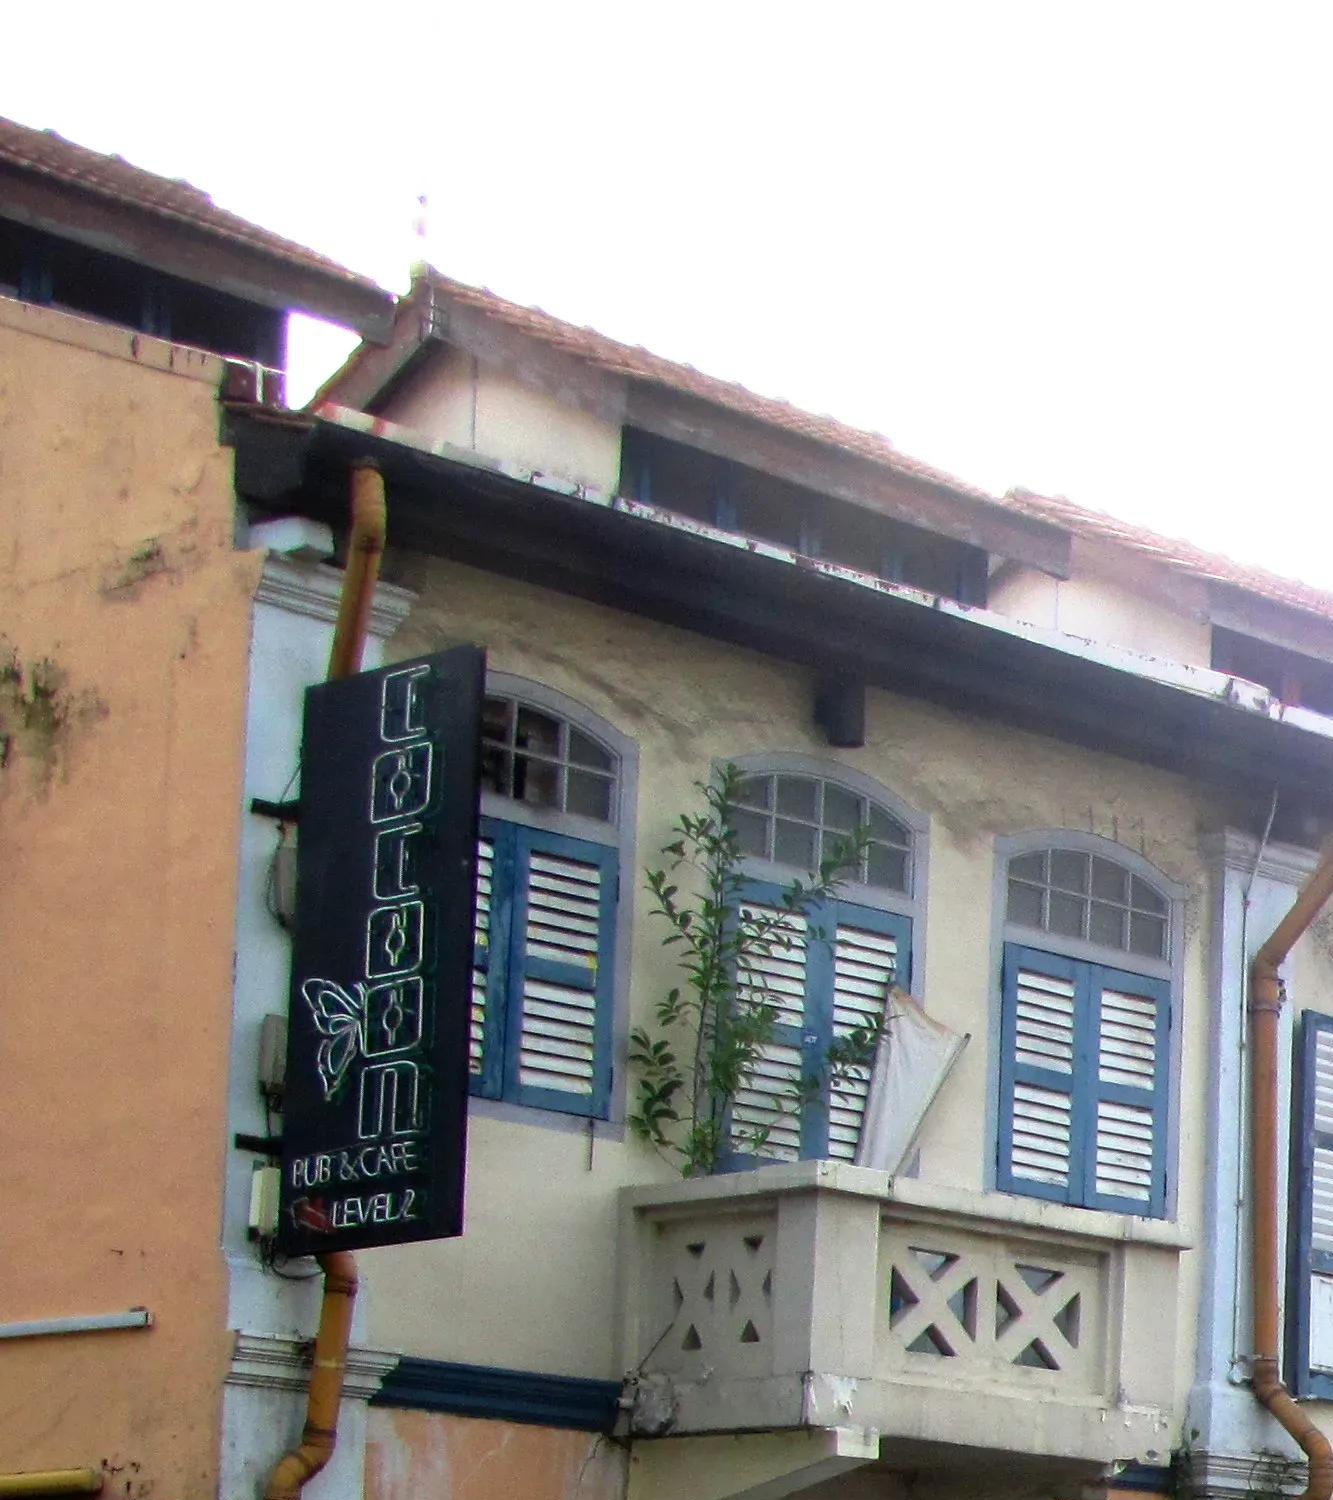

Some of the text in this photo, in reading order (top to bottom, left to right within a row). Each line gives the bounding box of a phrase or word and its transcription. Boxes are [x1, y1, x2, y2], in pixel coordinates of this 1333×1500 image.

[291, 1153, 332, 1189] PUB
[339, 1149, 359, 1182] &
[332, 1188, 415, 1228] LEVEL 2
